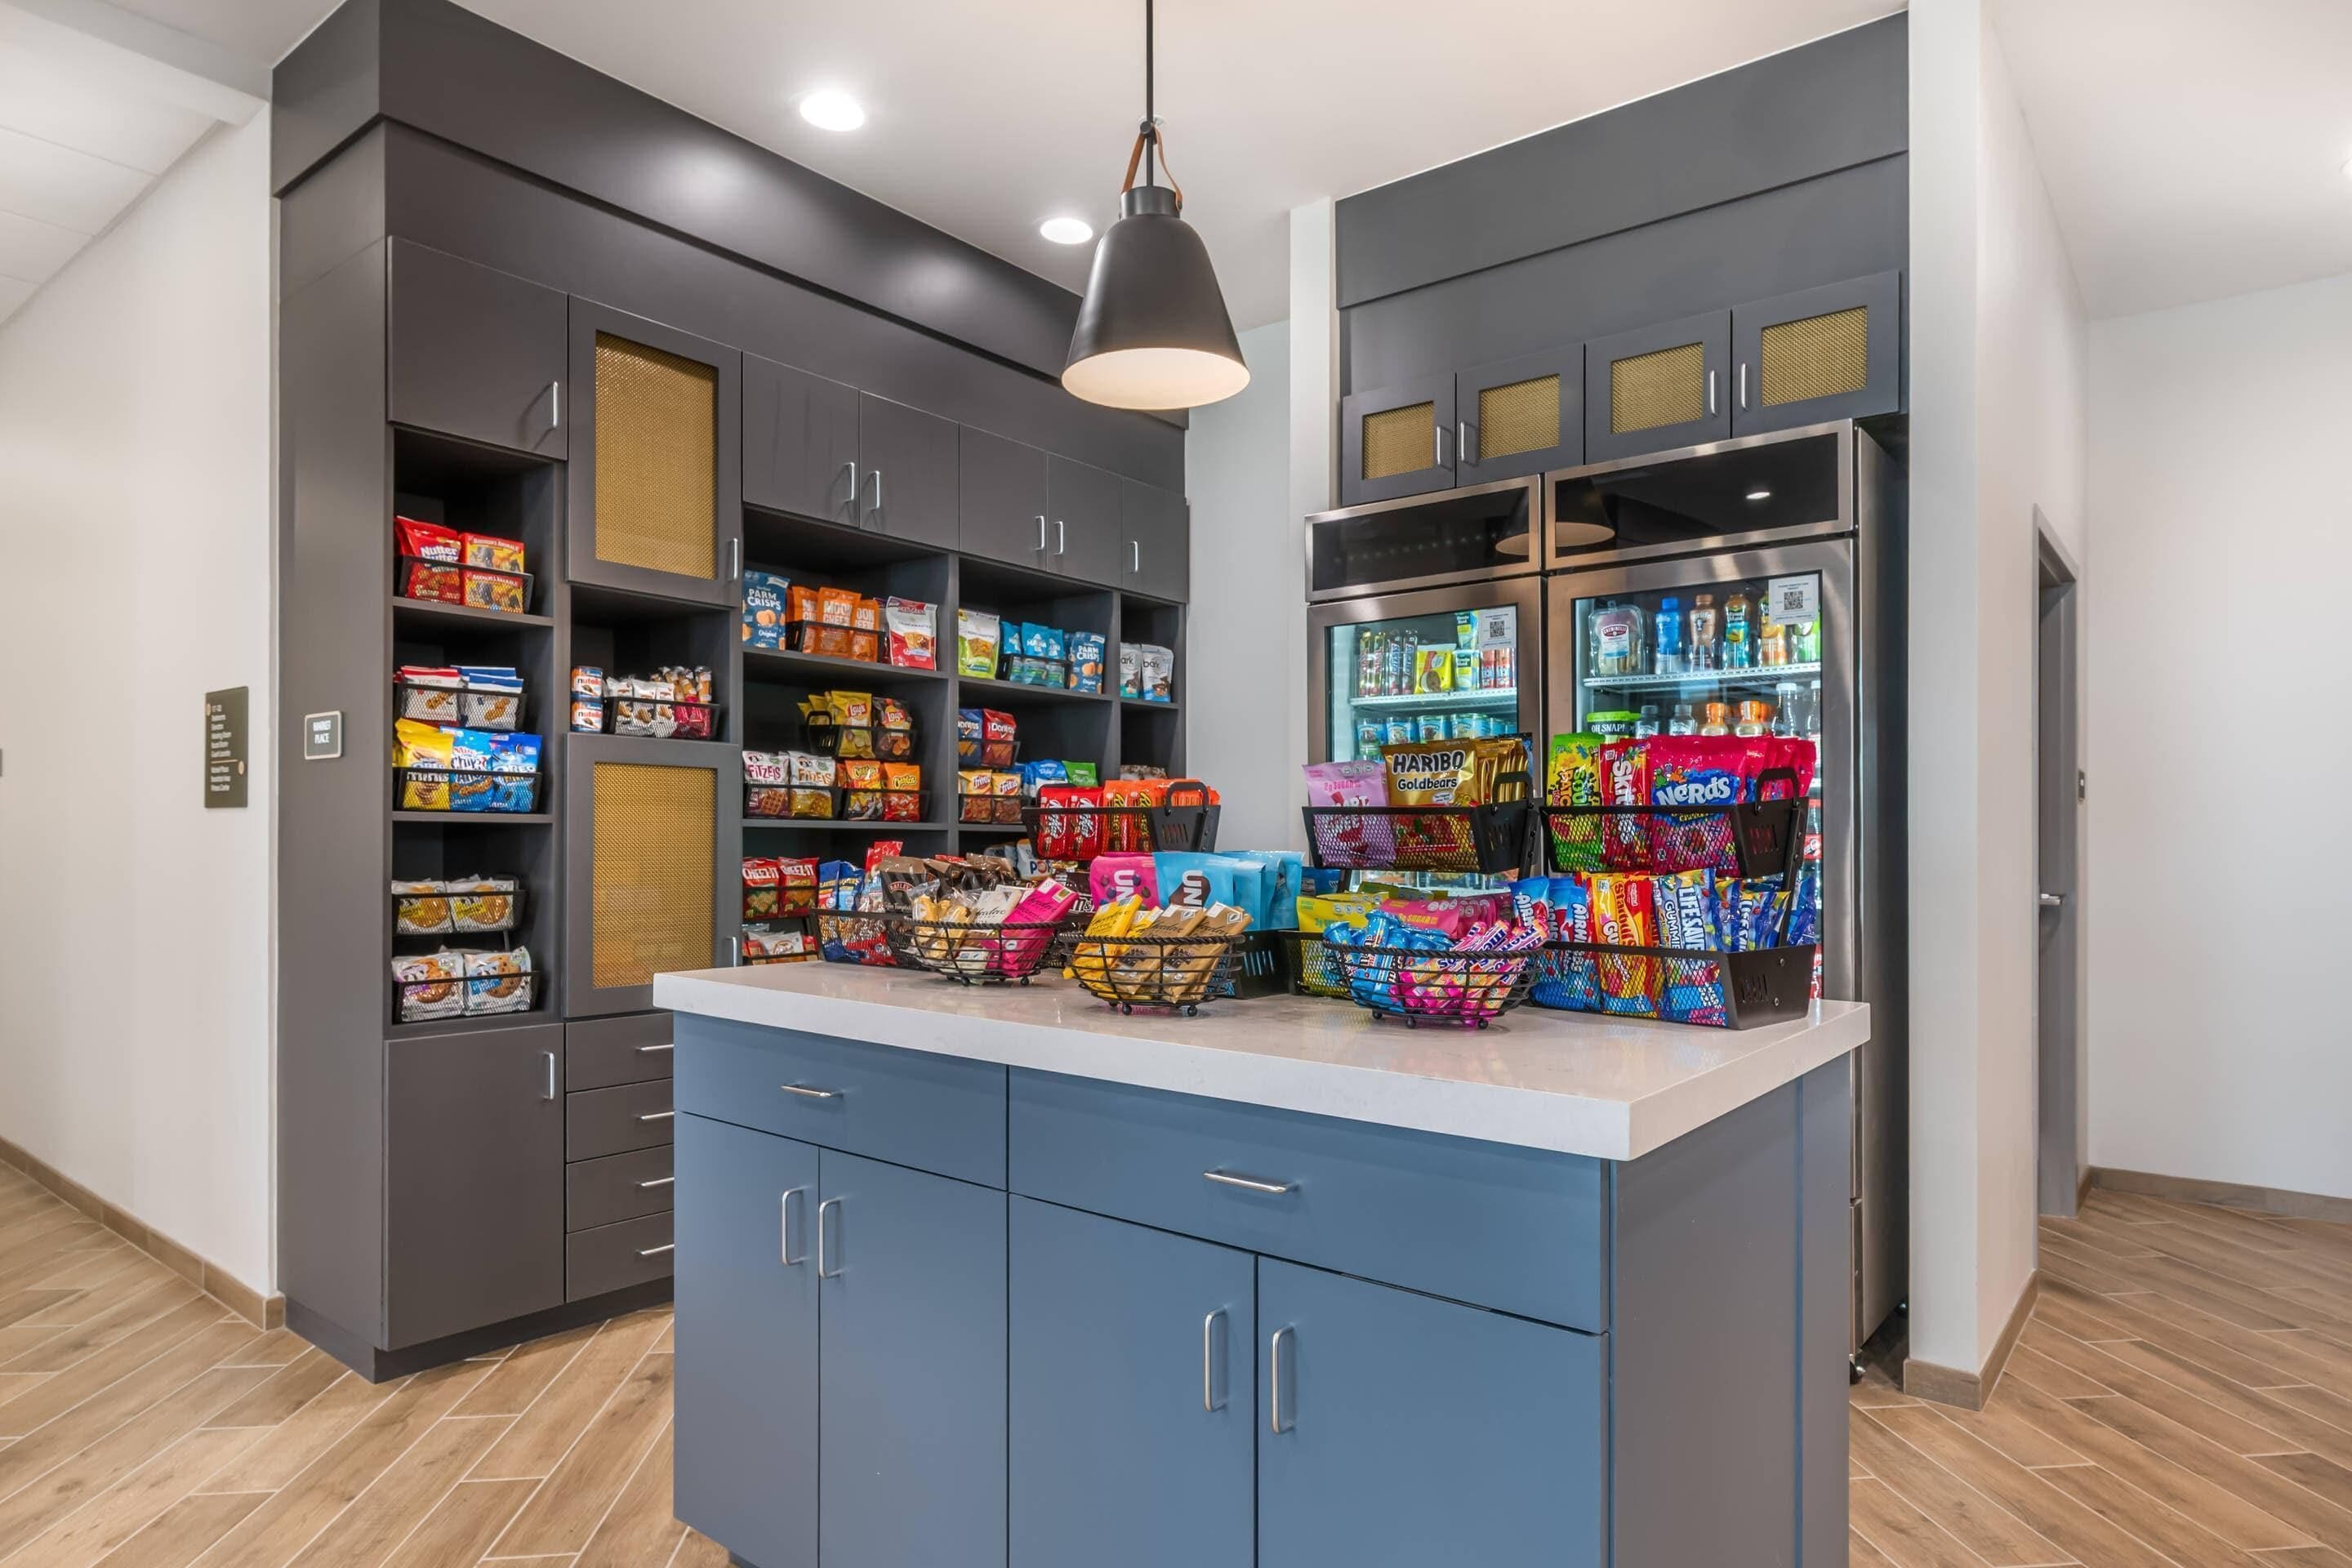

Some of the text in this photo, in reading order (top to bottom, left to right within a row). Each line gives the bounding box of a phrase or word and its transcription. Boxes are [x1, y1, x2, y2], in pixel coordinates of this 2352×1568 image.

[420, 546, 459, 556] Nutter
[748, 588, 777, 601] PARM
[746, 596, 782, 611] CRISPS
[823, 600, 853, 615] MOON
[1078, 645, 1099, 654] PARM
[849, 704, 866, 716] Lay's
[887, 711, 904, 722] Lay's
[991, 722, 1015, 734] Doritos
[1591, 724, 1625, 733] OH SNAP!
[1392, 750, 1466, 775] HARIBO
[892, 775, 916, 789] Cheetos
[1396, 777, 1458, 791] Goldbears
